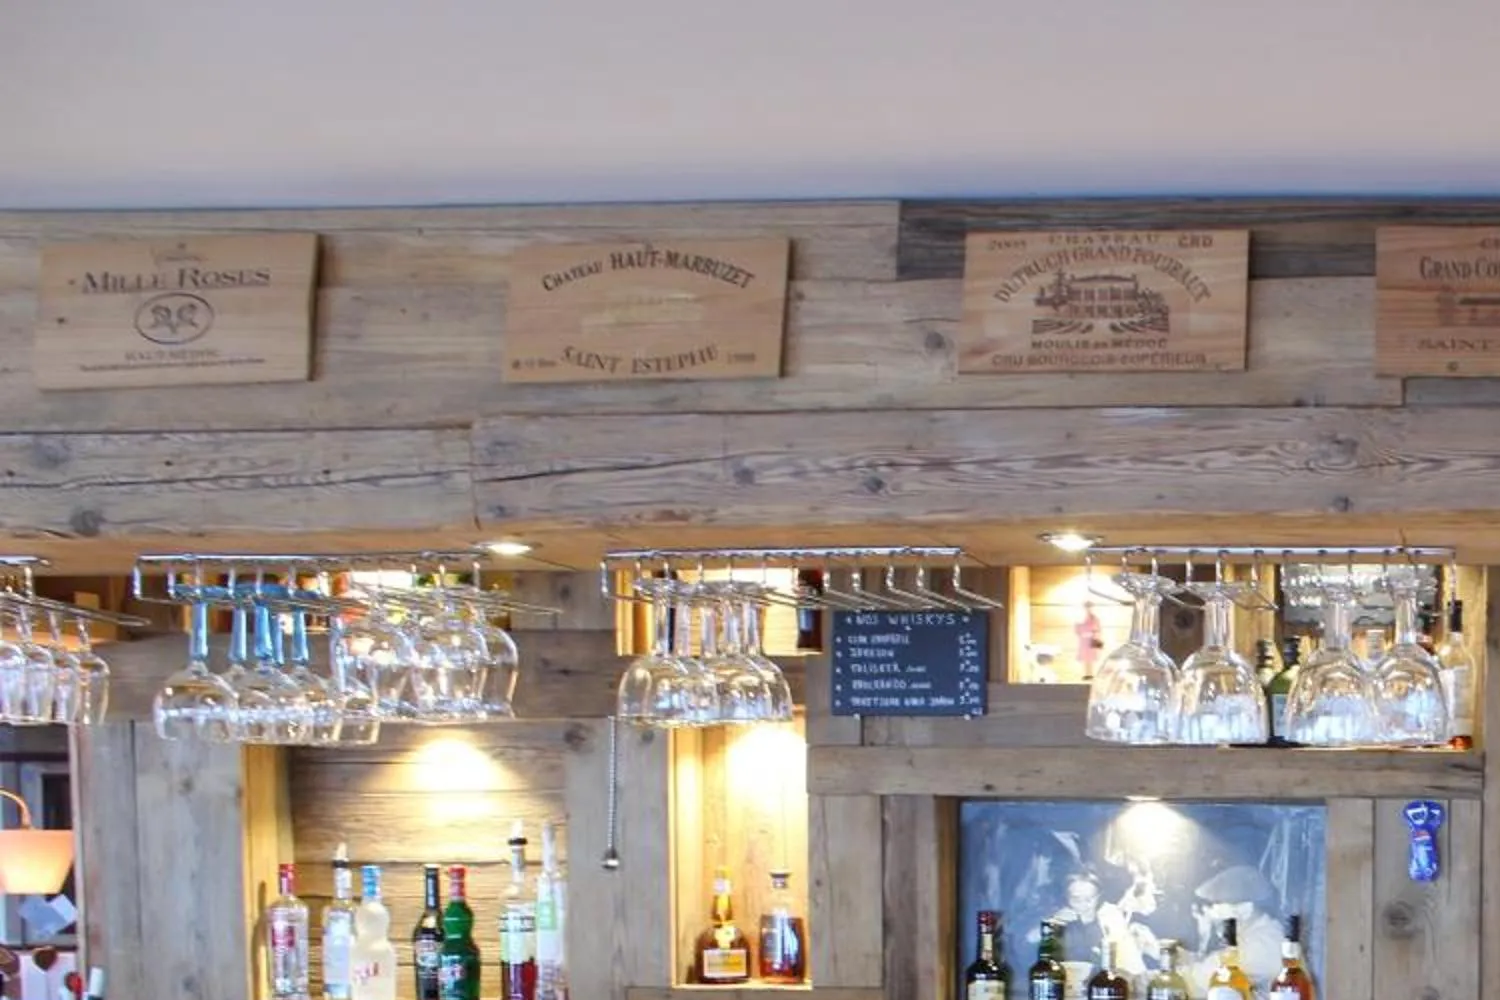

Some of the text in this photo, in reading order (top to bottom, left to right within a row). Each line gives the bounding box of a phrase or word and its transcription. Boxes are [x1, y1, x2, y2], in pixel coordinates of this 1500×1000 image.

[82, 267, 271, 294] MILLE ROSES
[888, 613, 957, 625] WHISKYS
